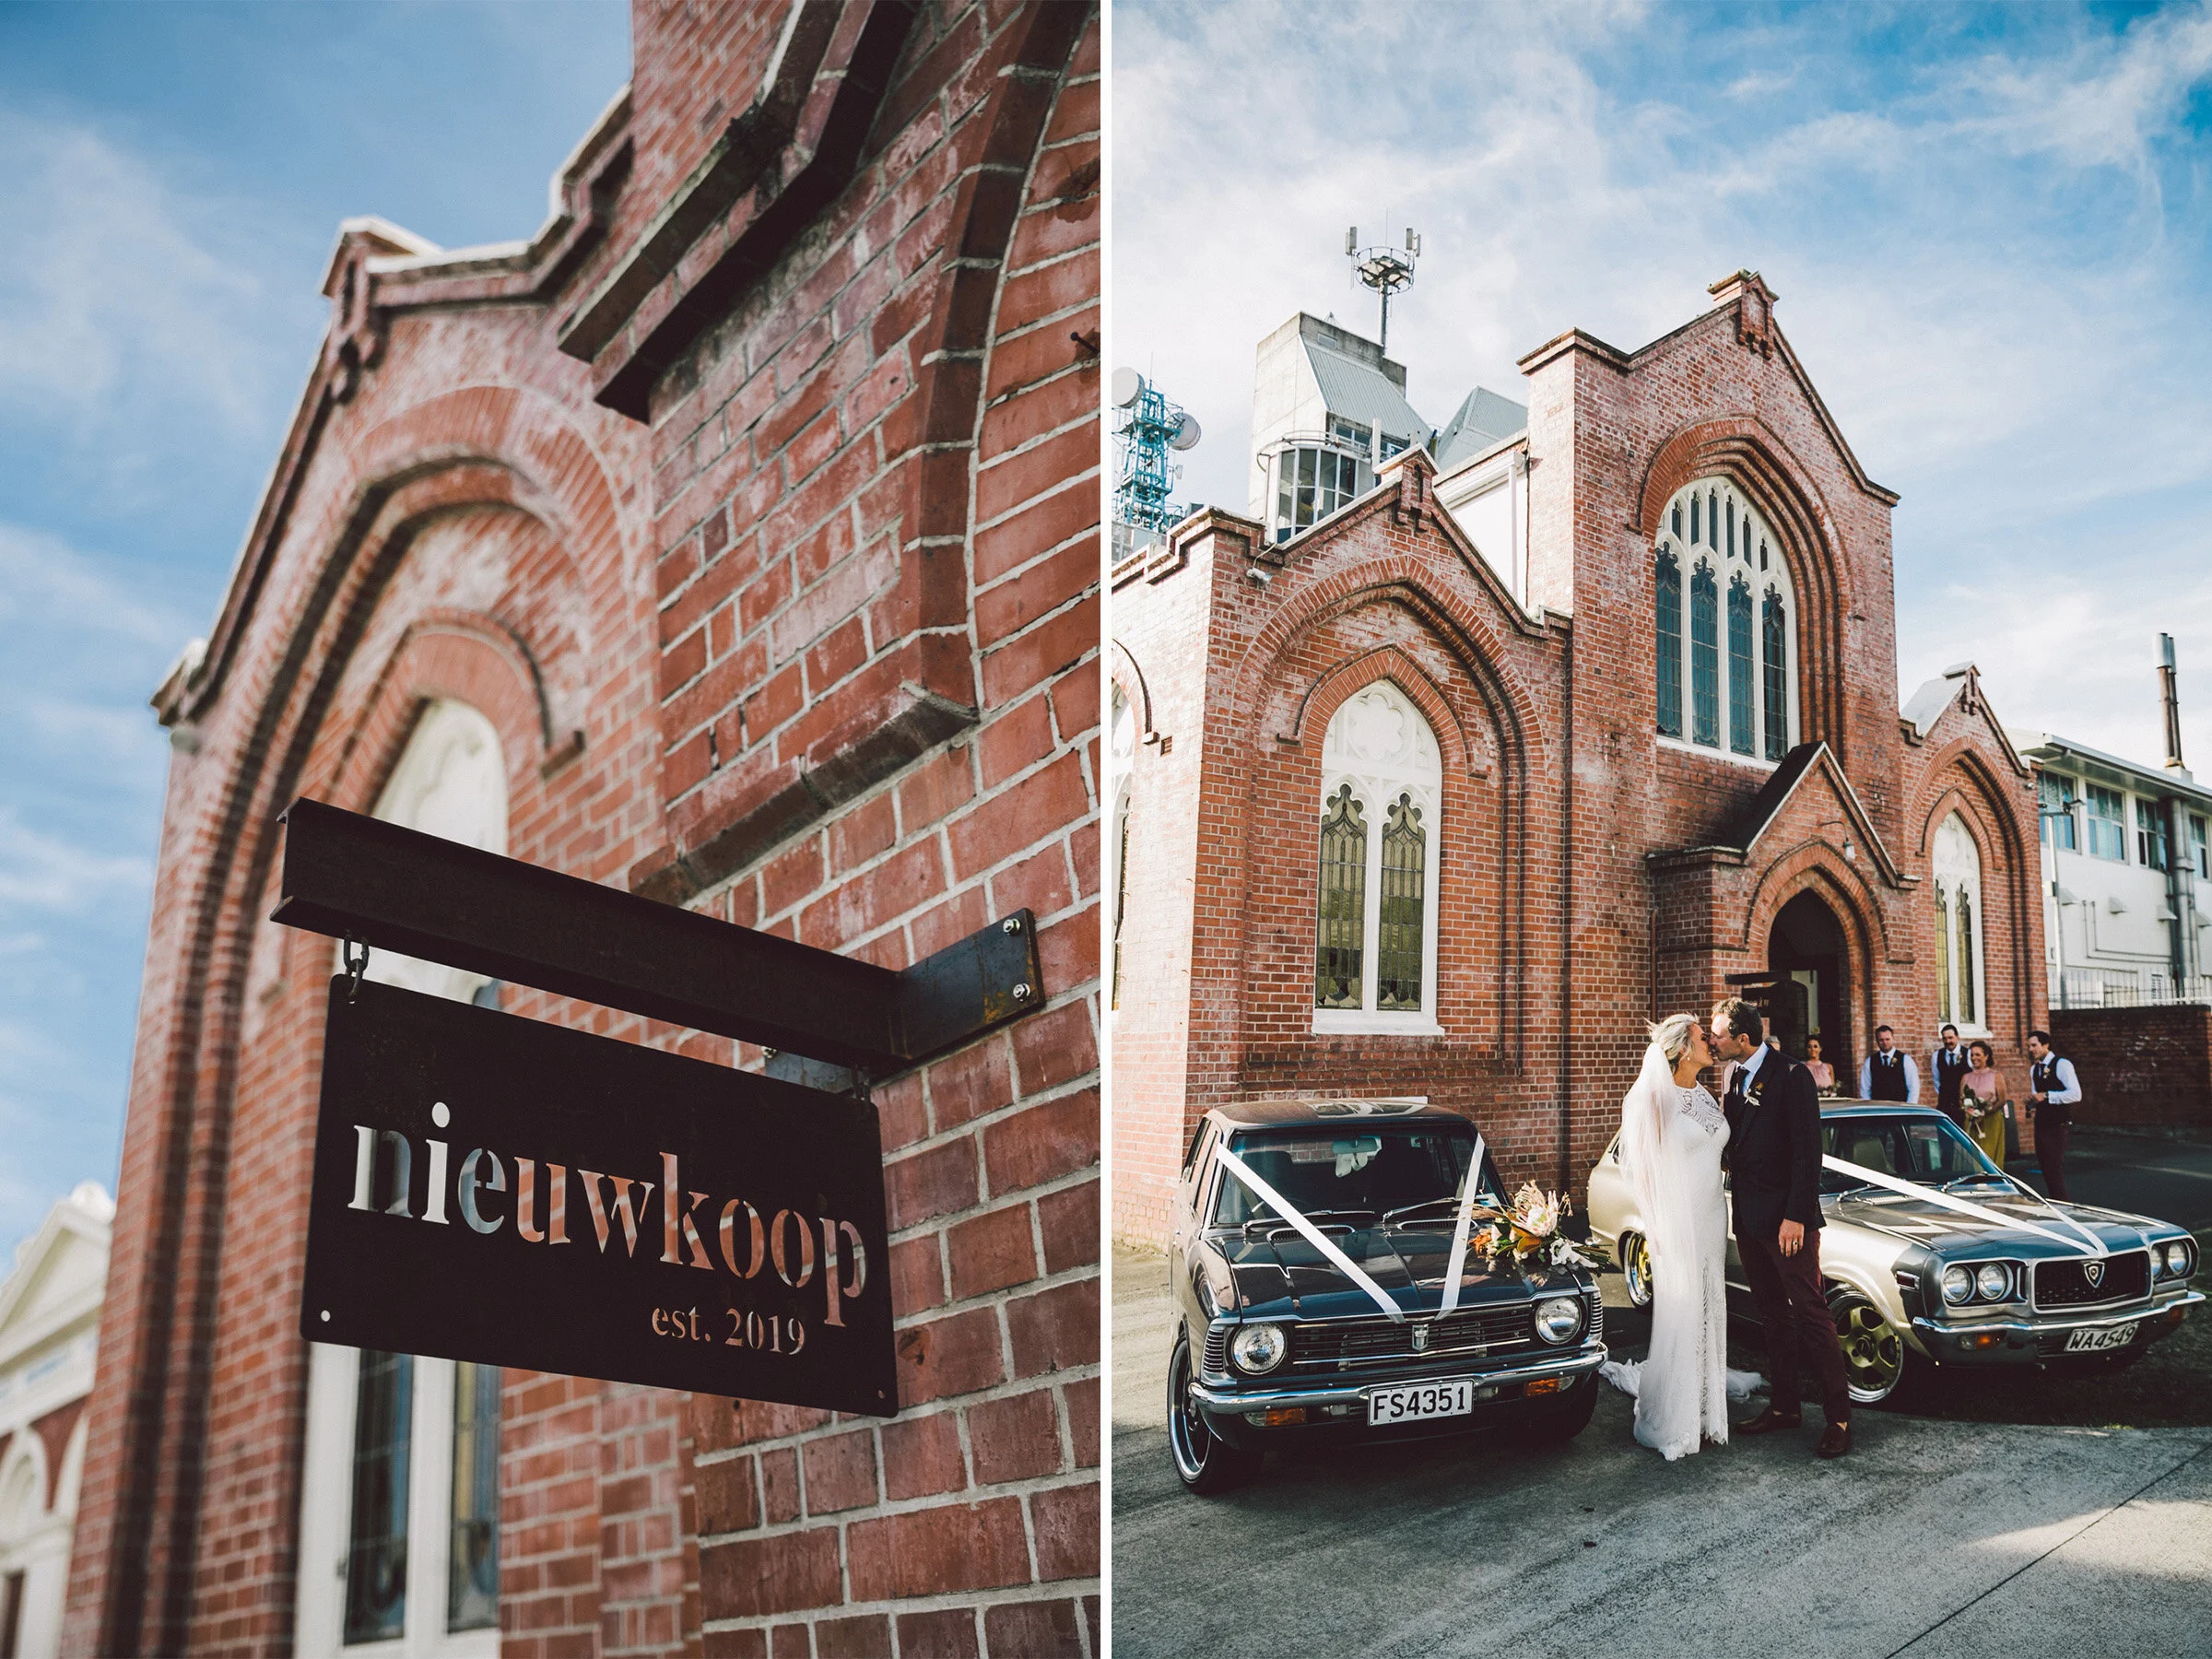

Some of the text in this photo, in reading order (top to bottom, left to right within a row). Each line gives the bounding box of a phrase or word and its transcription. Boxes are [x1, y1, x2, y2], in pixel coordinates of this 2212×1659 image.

[347, 1100, 867, 1328] nieuwkoop
[651, 1305, 806, 1356] est. 2019
[2069, 1326, 2136, 1349] WA4549
[1373, 1386, 1465, 1421] FS4351
